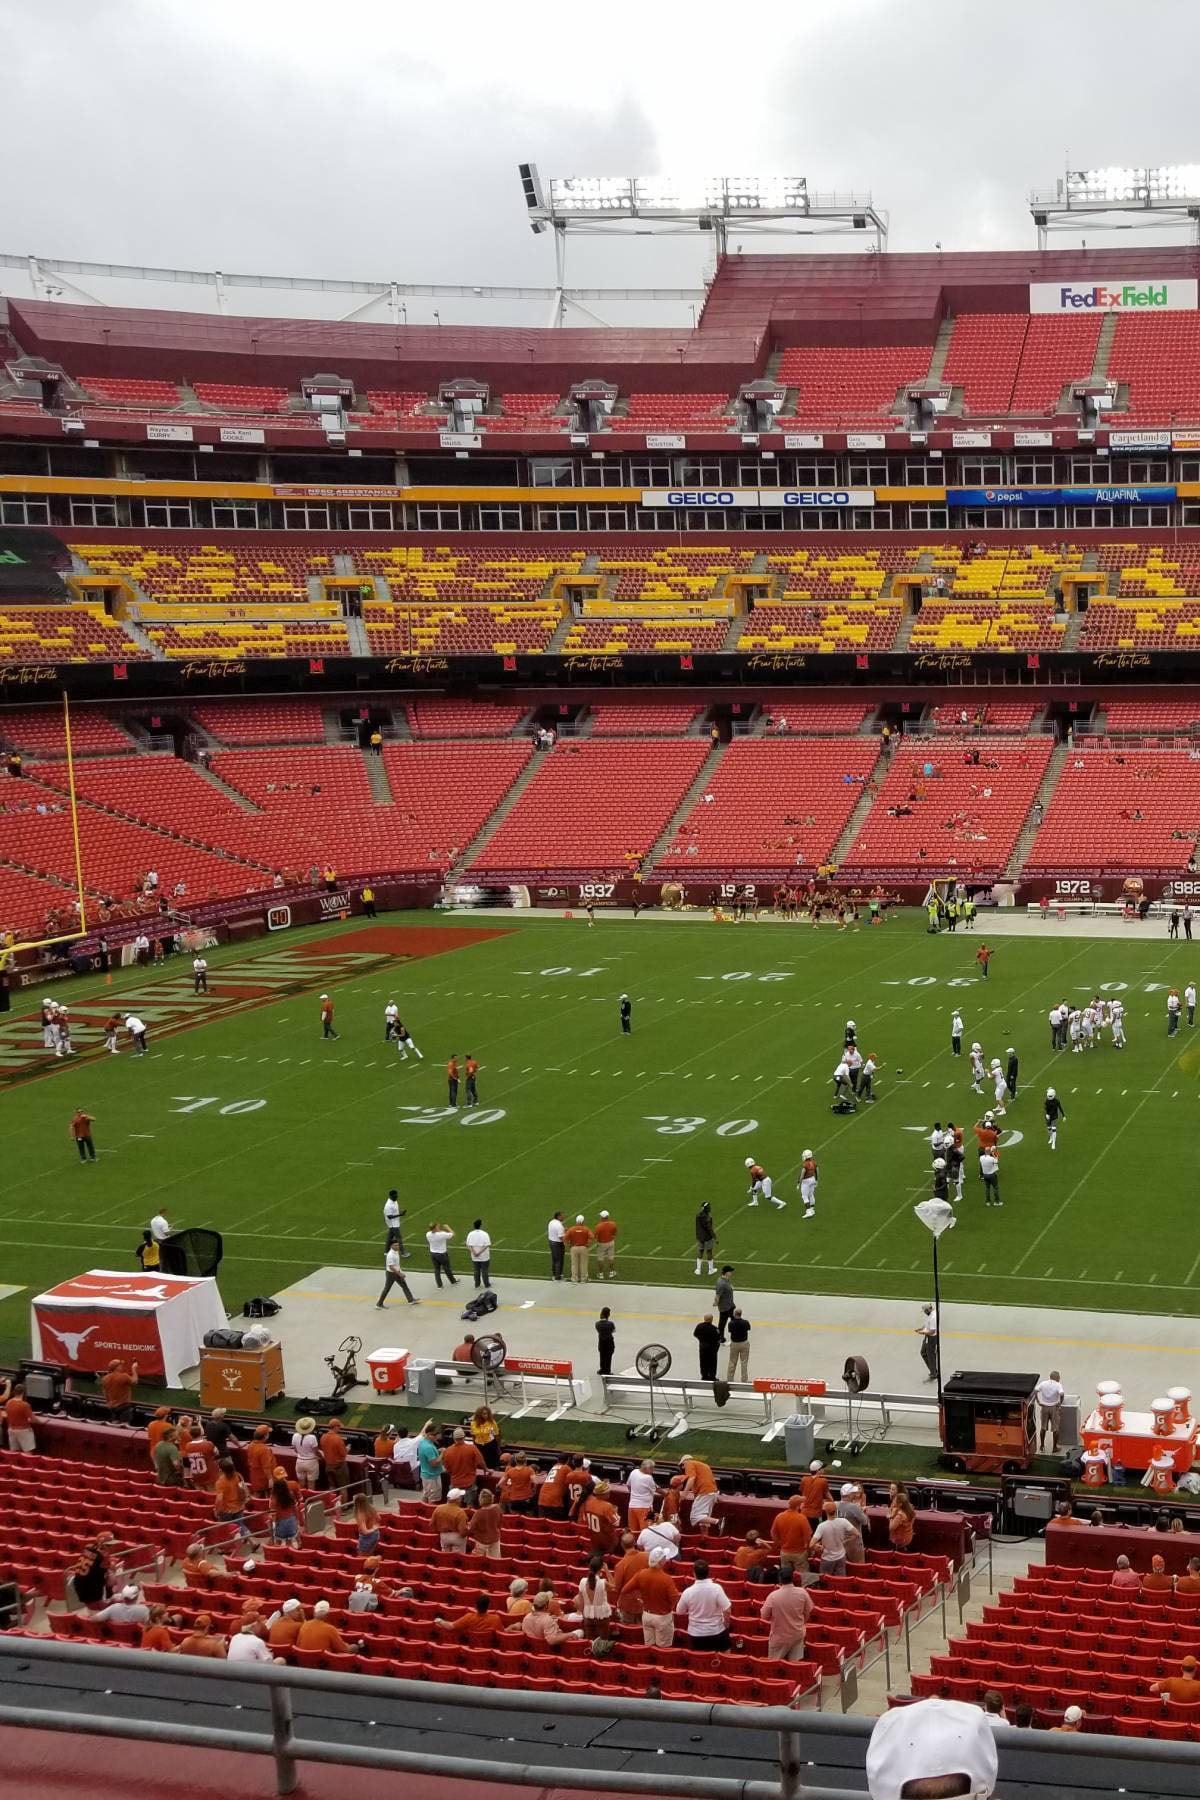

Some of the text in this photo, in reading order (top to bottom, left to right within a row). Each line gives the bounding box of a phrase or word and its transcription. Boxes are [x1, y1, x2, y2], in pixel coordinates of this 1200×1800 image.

[1060, 285, 1168, 308] FedExField
[1112, 433, 1159, 444] Carpetland
[668, 492, 733, 504] GEICO
[784, 492, 850, 504] GEICO
[998, 492, 1023, 502] pepsi
[579, 884, 616, 898] 1937
[720, 884, 756, 897] 192
[1056, 880, 1090, 894] 1972
[272, 909, 287, 924] 40
[94, 1341, 157, 1351] SPORTS MEDICINE
[518, 1362, 554, 1370] GATORADE
[374, 1367, 389, 1383] G
[770, 1383, 809, 1392] GATORADE
[1105, 1411, 1113, 1420] G
[1157, 1415, 1165, 1424] G
[1088, 1466, 1097, 1475] G
[1157, 1472, 1166, 1481] G
[586, 1512, 600, 1533] 10
